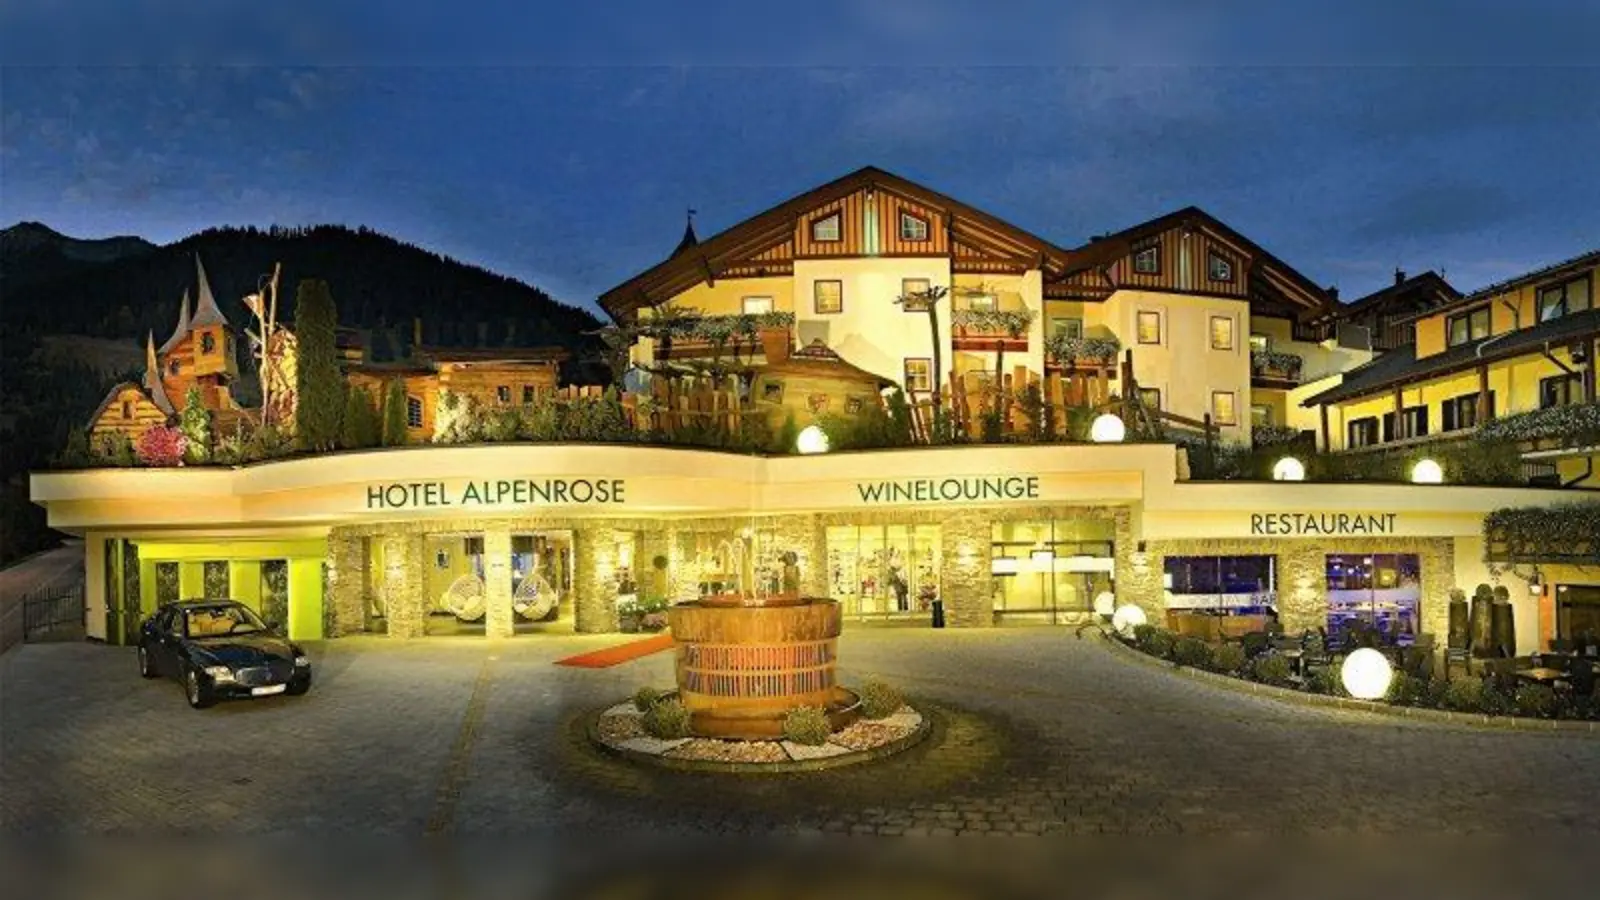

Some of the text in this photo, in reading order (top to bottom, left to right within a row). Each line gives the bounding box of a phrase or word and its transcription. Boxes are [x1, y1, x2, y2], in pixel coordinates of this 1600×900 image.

[367, 479, 625, 508] HOTEL ALPENROSE
[857, 477, 1039, 502] WINELOUNGE
[1251, 513, 1397, 535] RESTAURANT
